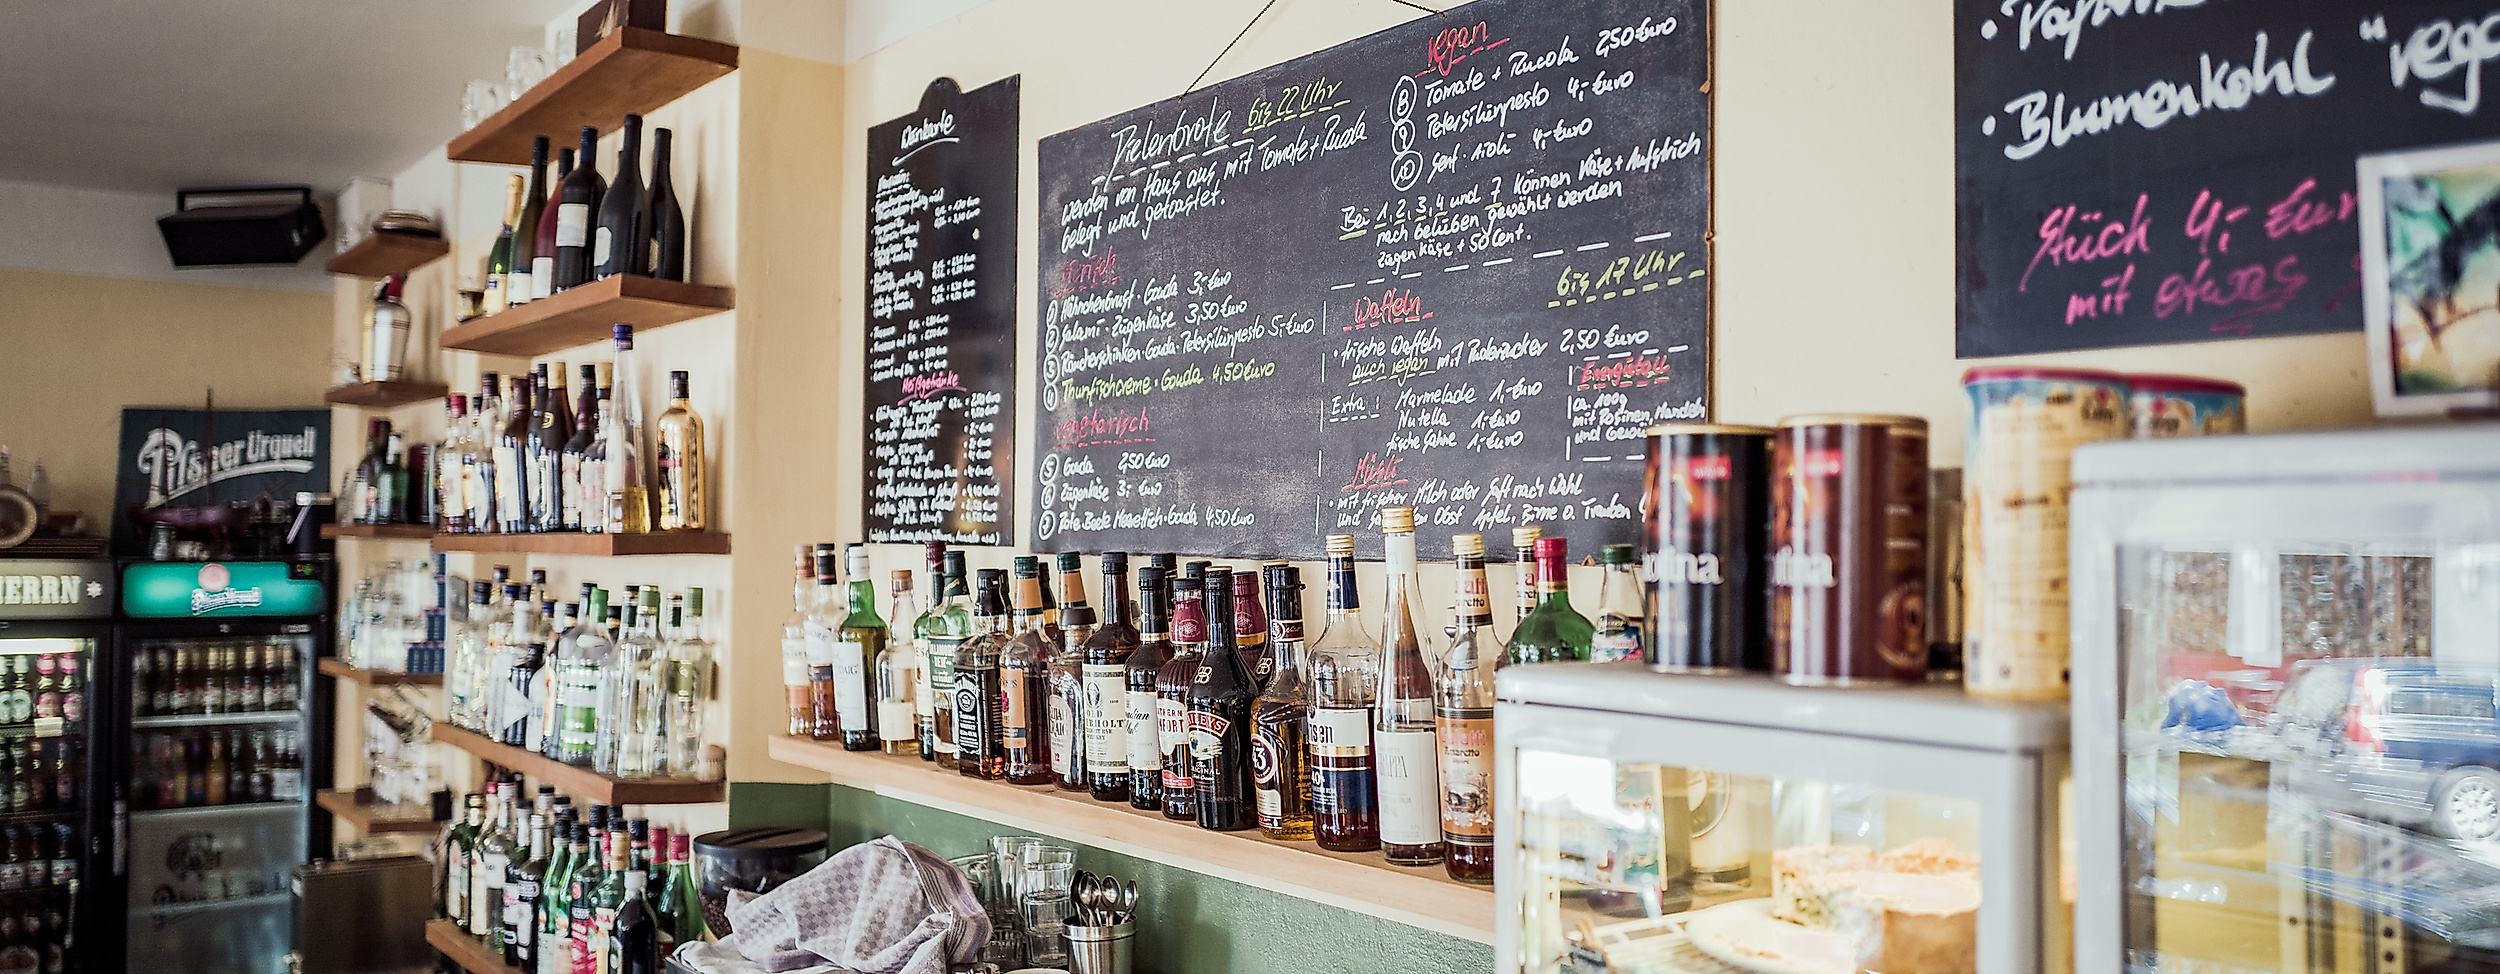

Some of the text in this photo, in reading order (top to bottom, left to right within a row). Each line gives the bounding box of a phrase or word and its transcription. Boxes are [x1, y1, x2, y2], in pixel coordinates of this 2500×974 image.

[1424, 74, 1486, 108] Tomate
[1508, 35, 1580, 78] Rucola
[1595, 28, 1637, 58] 2,50
[1635, 15, 1679, 43] Euro
[1428, 20, 1489, 77] vegan
[1249, 97, 1273, 128] bis
[1276, 88, 1299, 116] 22
[1300, 76, 1343, 112] Uhr
[1590, 69, 1636, 96] Euro
[2002, 30, 2338, 161] Blumenkohl
[1552, 116, 1594, 143] Euro
[1061, 186, 1108, 226] werden
[1114, 186, 1137, 208] von
[1142, 170, 1182, 203] Haus
[1186, 160, 1218, 187] aus
[1224, 144, 1252, 181] mit
[1259, 126, 1307, 171] Tomate
[1322, 110, 1369, 157] Rucola
[1340, 205, 1370, 231] Bei
[1449, 183, 1481, 211] und
[1490, 175, 1503, 202] 7
[1577, 148, 1614, 181] Käse
[1623, 131, 1702, 174] Aufstrich
[1061, 178, 1226, 258] belegt und getoastet.
[1376, 178, 1625, 248] nach belieben gewählt werden
[2018, 193, 2151, 293] Stück
[2265, 178, 2357, 239] Eur
[1060, 246, 1116, 285] tierisch
[1556, 247, 1687, 298] bis 17 Uhr
[1060, 278, 1138, 323] Hähnchenbrust
[1143, 273, 1179, 305] Gouda
[1353, 287, 1423, 324] Waffeln
[2066, 264, 2136, 325] mit
[1059, 318, 1106, 351] Salami
[1184, 301, 1219, 325] 3,50
[1218, 294, 1249, 318] Euro
[1145, 335, 1177, 360] Gouda
[1285, 311, 1316, 335] Euro
[1340, 326, 1442, 369] frische Waffeln
[1351, 322, 1651, 388] auch vegan mit Puderzucker 2,50 Euro
[1061, 374, 1152, 408] Thunfischcreme
[1160, 361, 1205, 392] Gouda
[1211, 363, 1244, 386] 4,50
[1242, 357, 1276, 382] Euro
[1330, 395, 1366, 417] Extra
[1393, 382, 1478, 412] Marmelade
[1511, 377, 1543, 400] Euro
[1055, 406, 1151, 445] vegetarisch
[1397, 407, 1452, 431] Nutella
[1489, 409, 1521, 429] Euro
[1572, 410, 1597, 429] mit
[1653, 396, 1706, 421] Mandeln
[1574, 422, 1647, 446] und Gewü
[1062, 454, 1095, 477] Gouda
[1117, 451, 1145, 476] 2,50
[1143, 450, 1172, 470] Euro
[1485, 431, 1525, 451] Euro
[137, 425, 318, 510] Pilsner Urquell
[1351, 451, 1404, 487] Müsli
[1336, 507, 1361, 529] und
[1433, 505, 1464, 527] Obst
[1580, 492, 1632, 522] Trauben
[1337, 493, 1359, 511] mit
[1412, 477, 1449, 507] Milch
[1450, 480, 1480, 502] oder
[1513, 475, 1546, 499] nach
[1547, 471, 1585, 496] Wahl
[1057, 510, 1081, 536] Rote
[1167, 501, 1199, 528] Gouda
[1205, 505, 1232, 529] 4,50
[1230, 506, 1256, 527] Euro
[0, 575, 82, 605] ERRN
